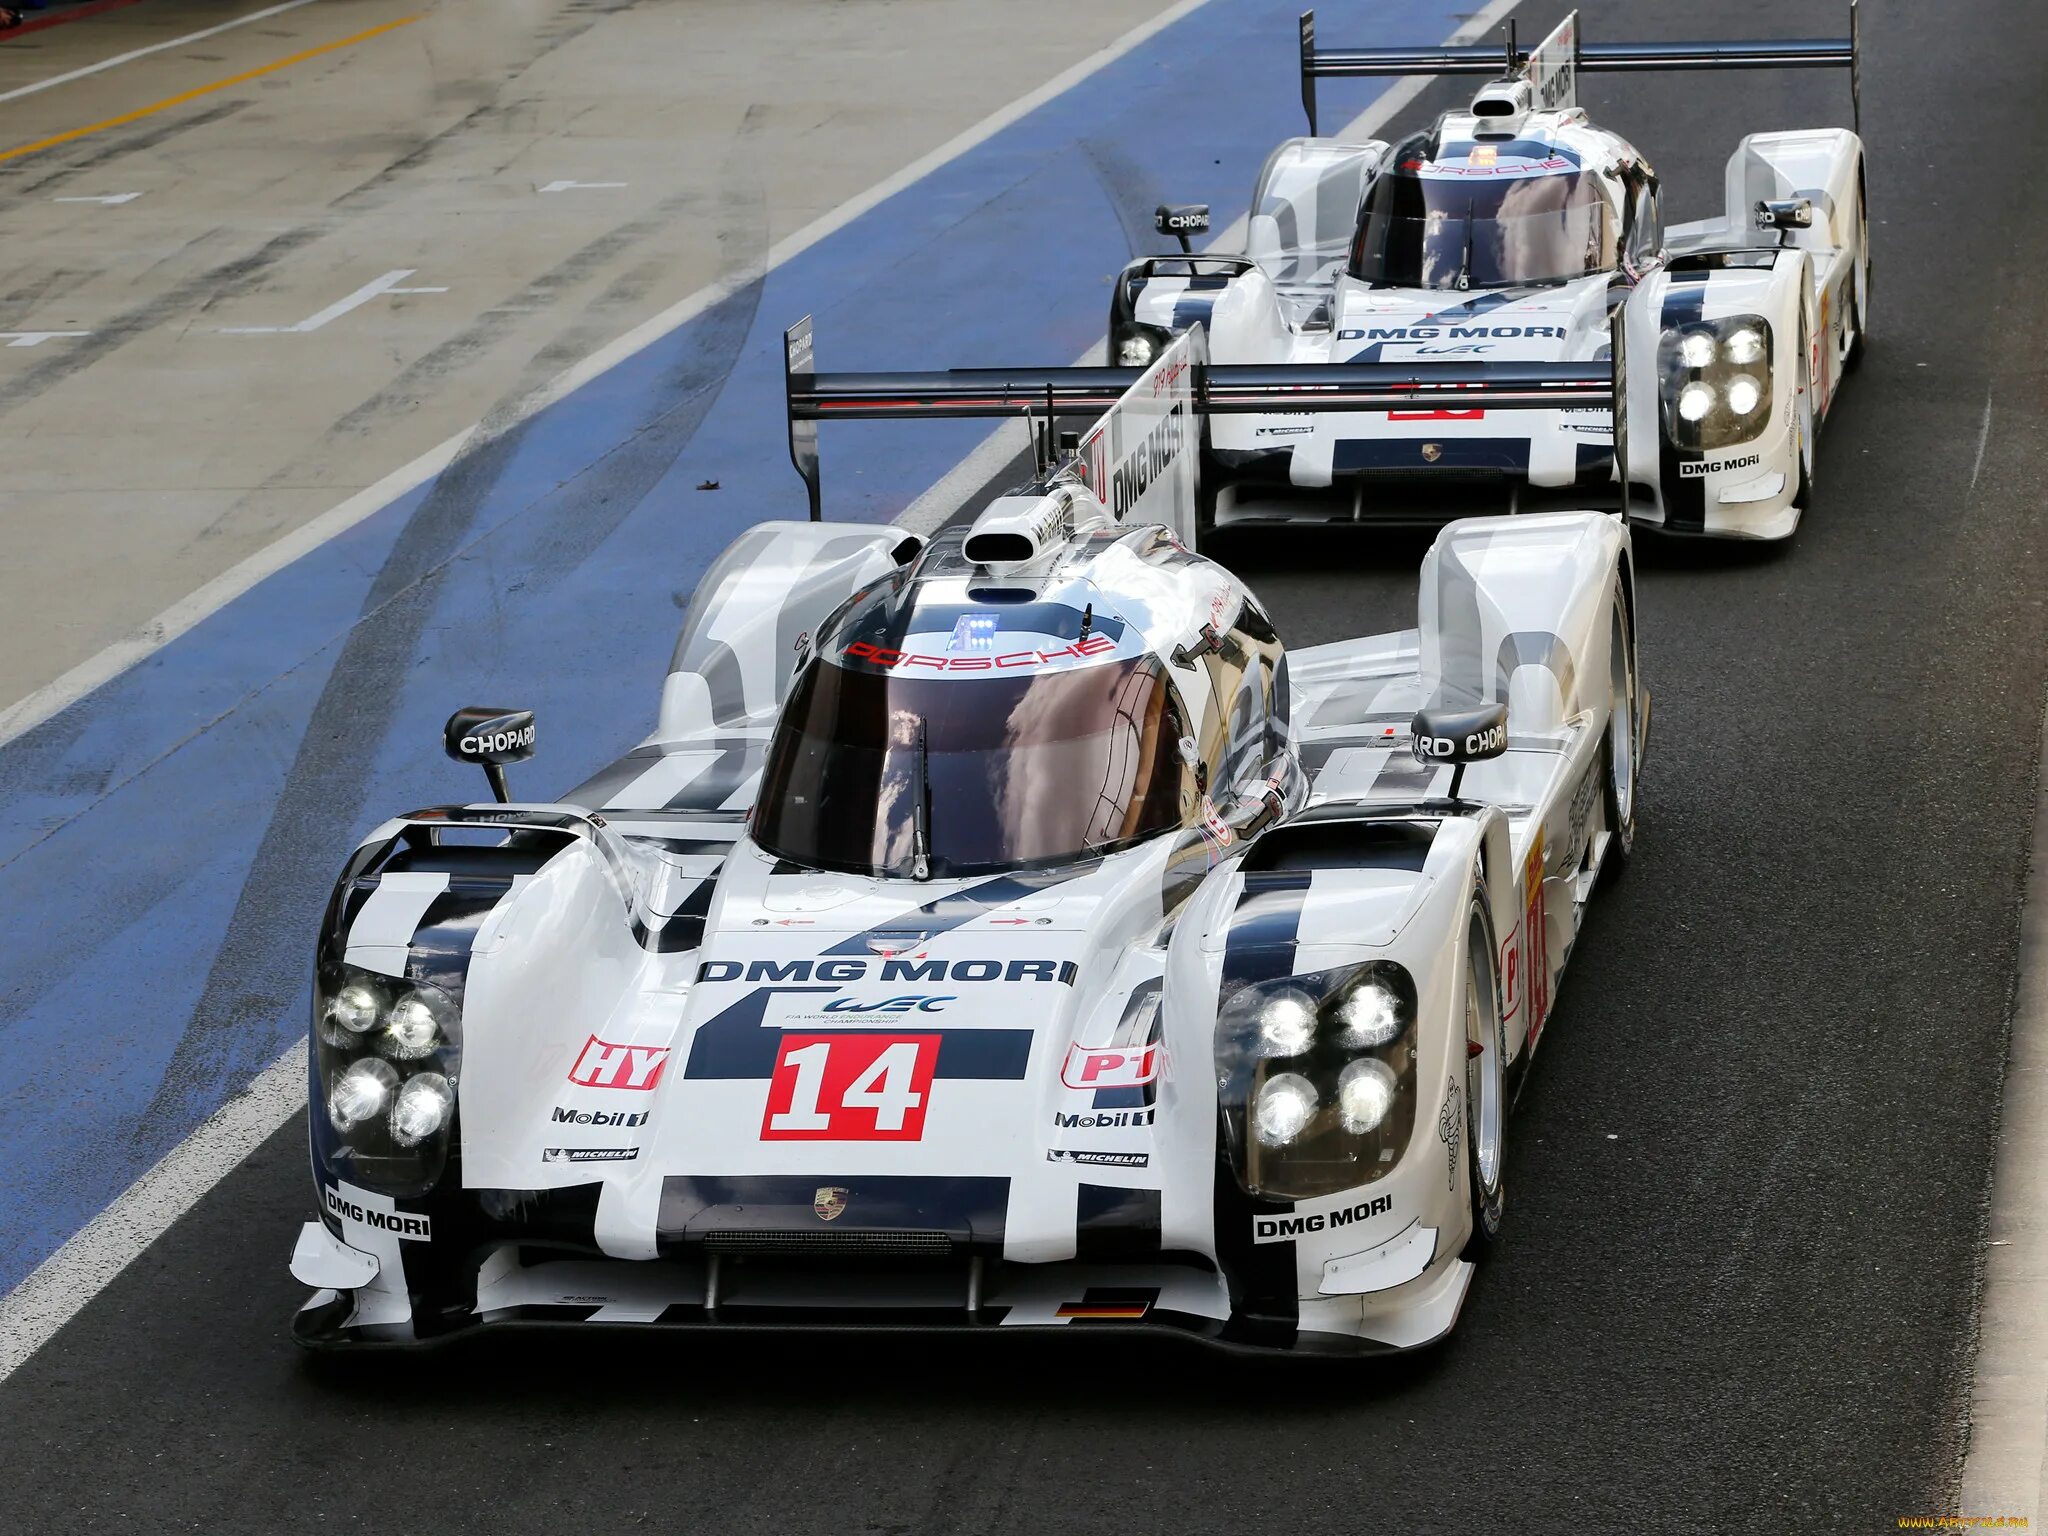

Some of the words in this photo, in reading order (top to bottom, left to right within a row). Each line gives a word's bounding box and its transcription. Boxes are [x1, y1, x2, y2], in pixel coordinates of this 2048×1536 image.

[1337, 328, 1440, 341] DMG
[1448, 327, 1567, 341] MORI
[1113, 441, 1147, 522] DMG
[1148, 400, 1185, 484] MORI
[1682, 462, 1721, 475] DMG
[1724, 454, 1760, 471] MORI
[843, 636, 1116, 671] PORSCHE
[460, 725, 535, 754] CHOPARD
[693, 960, 870, 985] DMG
[880, 959, 1080, 988] MORI
[821, 994, 958, 1012] WEC
[572, 1039, 671, 1087] HY
[1081, 1049, 1156, 1082] P1
[769, 1042, 921, 1131] 14
[551, 1106, 626, 1127] Mobil
[629, 1110, 649, 1128] 1
[1054, 1111, 1128, 1128] Mobil
[1134, 1110, 1154, 1127] 1
[571, 1150, 638, 1159] MICHELIN
[1077, 1153, 1148, 1164] MICHELIN
[327, 1190, 363, 1223] DMG
[366, 1209, 430, 1236] MORI
[1257, 1214, 1325, 1238] DMG
[1329, 1193, 1392, 1229] MORI
